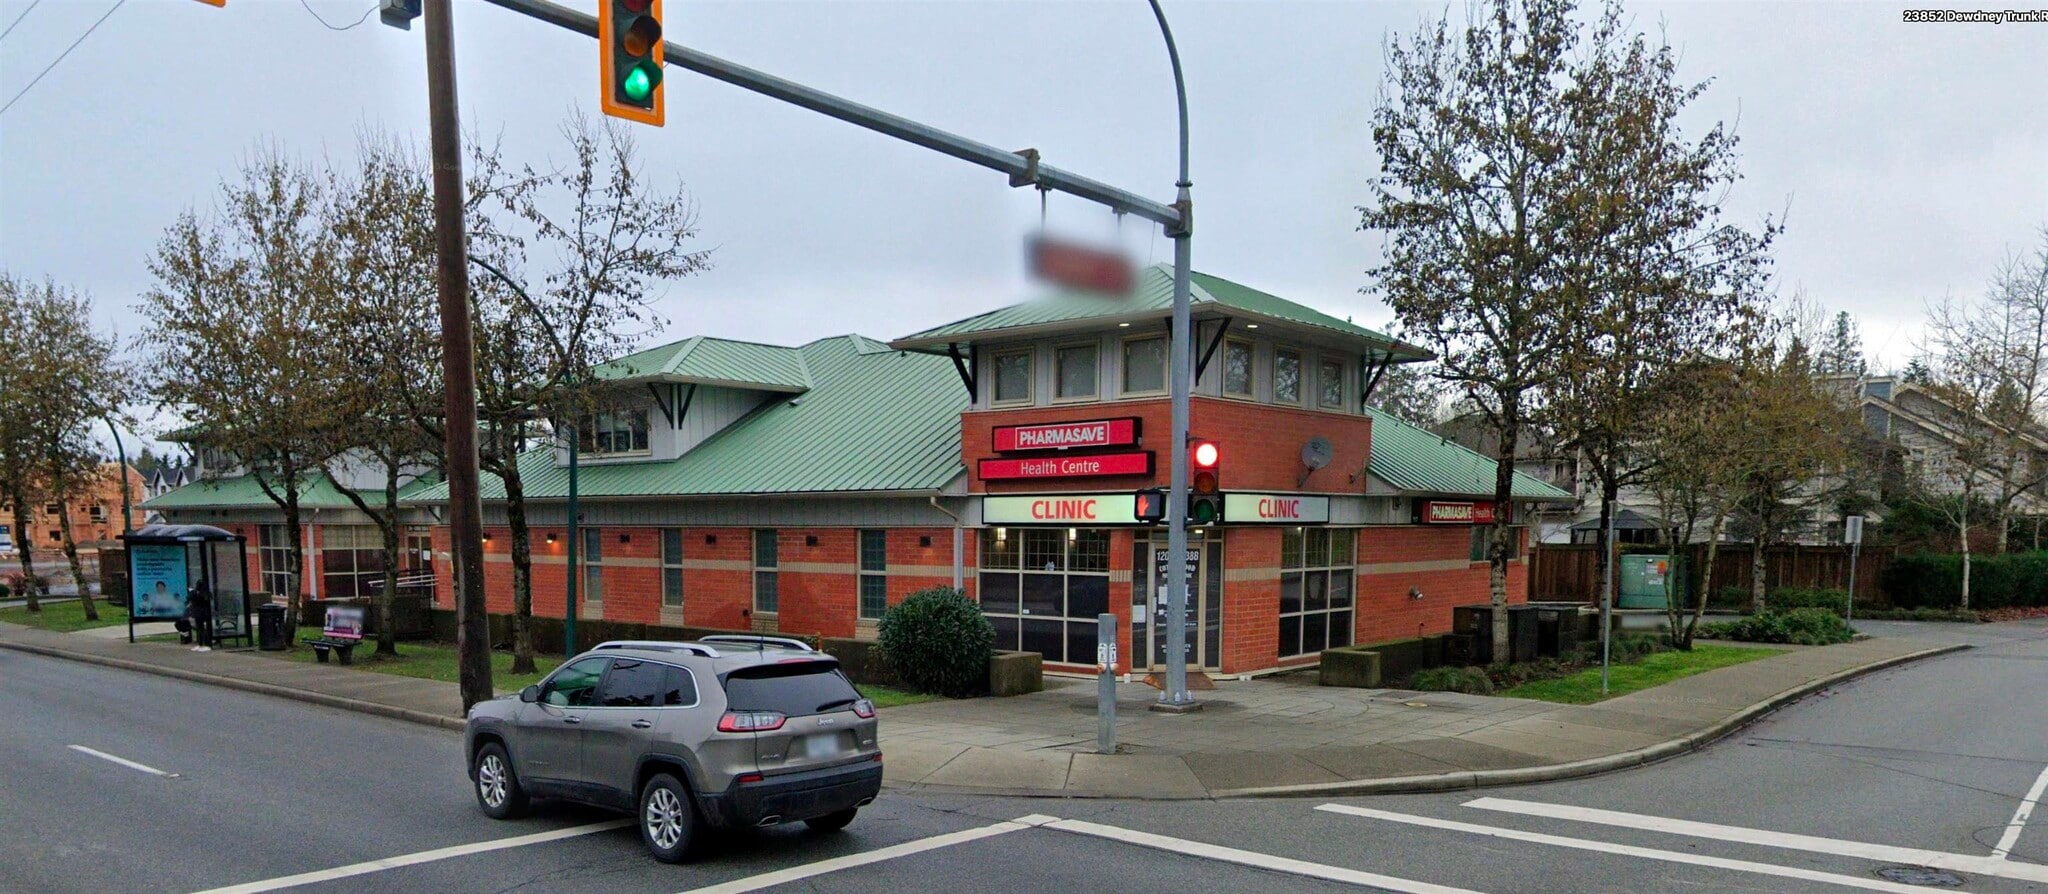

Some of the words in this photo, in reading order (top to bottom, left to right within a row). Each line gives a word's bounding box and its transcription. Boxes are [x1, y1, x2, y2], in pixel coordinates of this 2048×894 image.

[1020, 426, 1105, 445] PHARMASAVE
[1020, 460, 1057, 475] Health
[1061, 460, 1100, 473] Centre
[1031, 499, 1097, 520] CLINIC
[1258, 498, 1299, 518] CLINIC
[1431, 505, 1473, 519] PHARMASAVE
